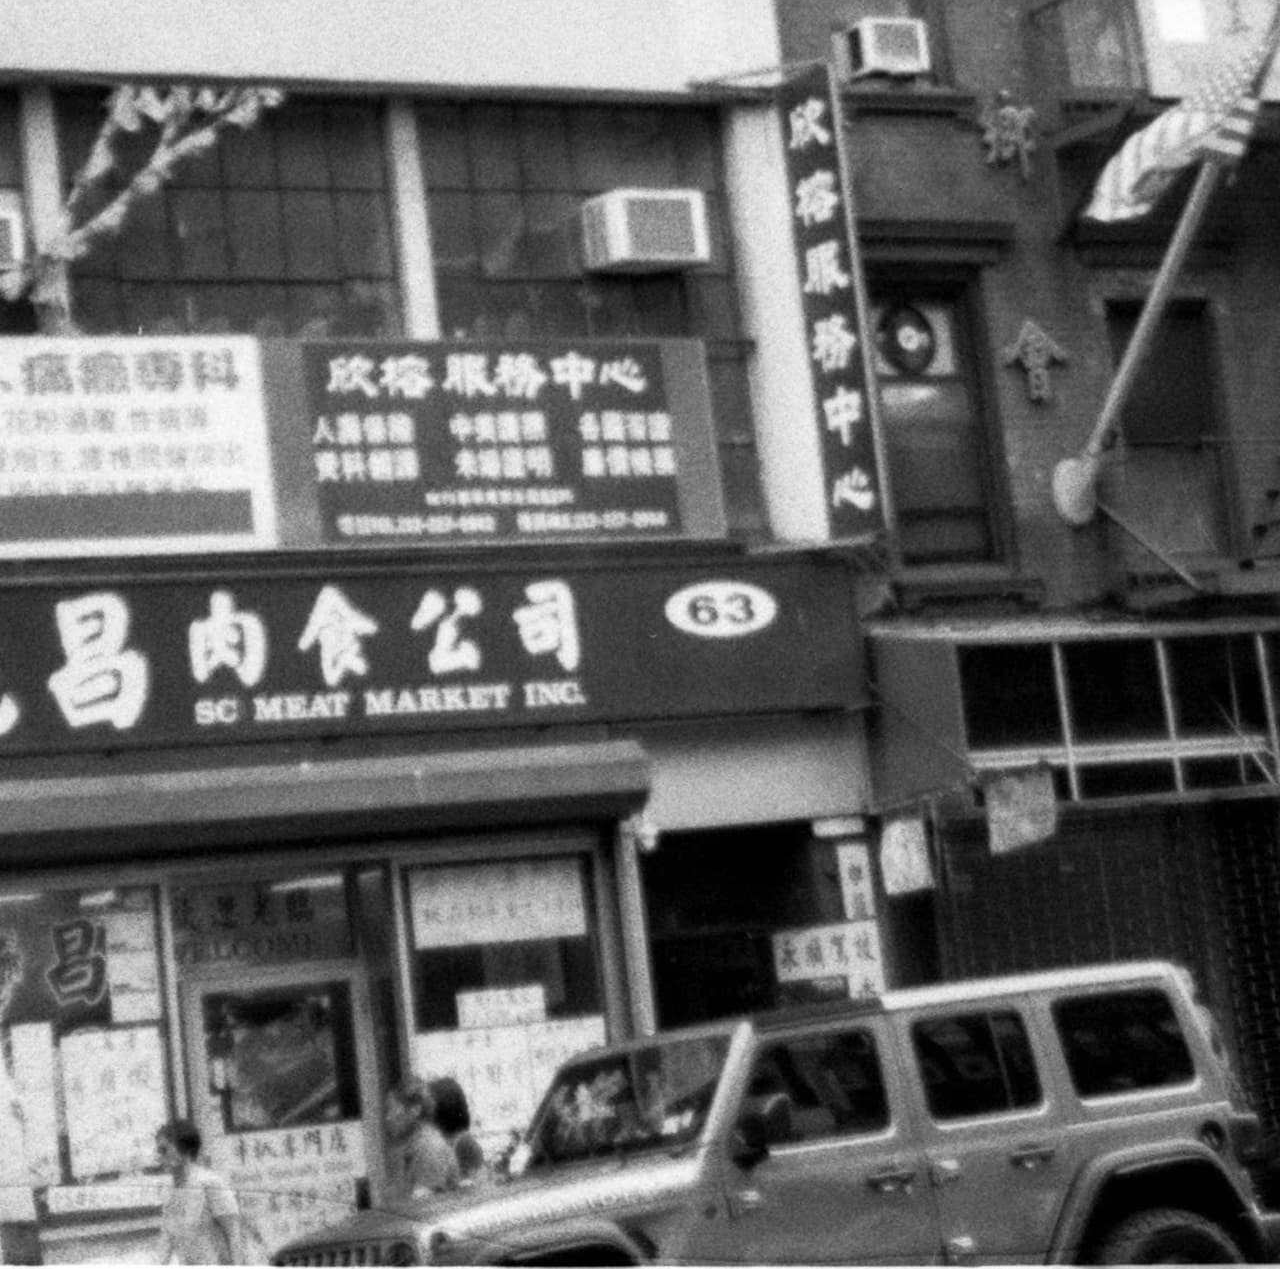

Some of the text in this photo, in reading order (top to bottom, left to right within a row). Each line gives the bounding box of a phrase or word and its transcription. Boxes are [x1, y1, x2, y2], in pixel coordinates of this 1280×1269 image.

[685, 592, 756, 627] 63
[193, 699, 239, 725] SC
[252, 693, 351, 723] MEAT
[365, 686, 511, 717] MARKET
